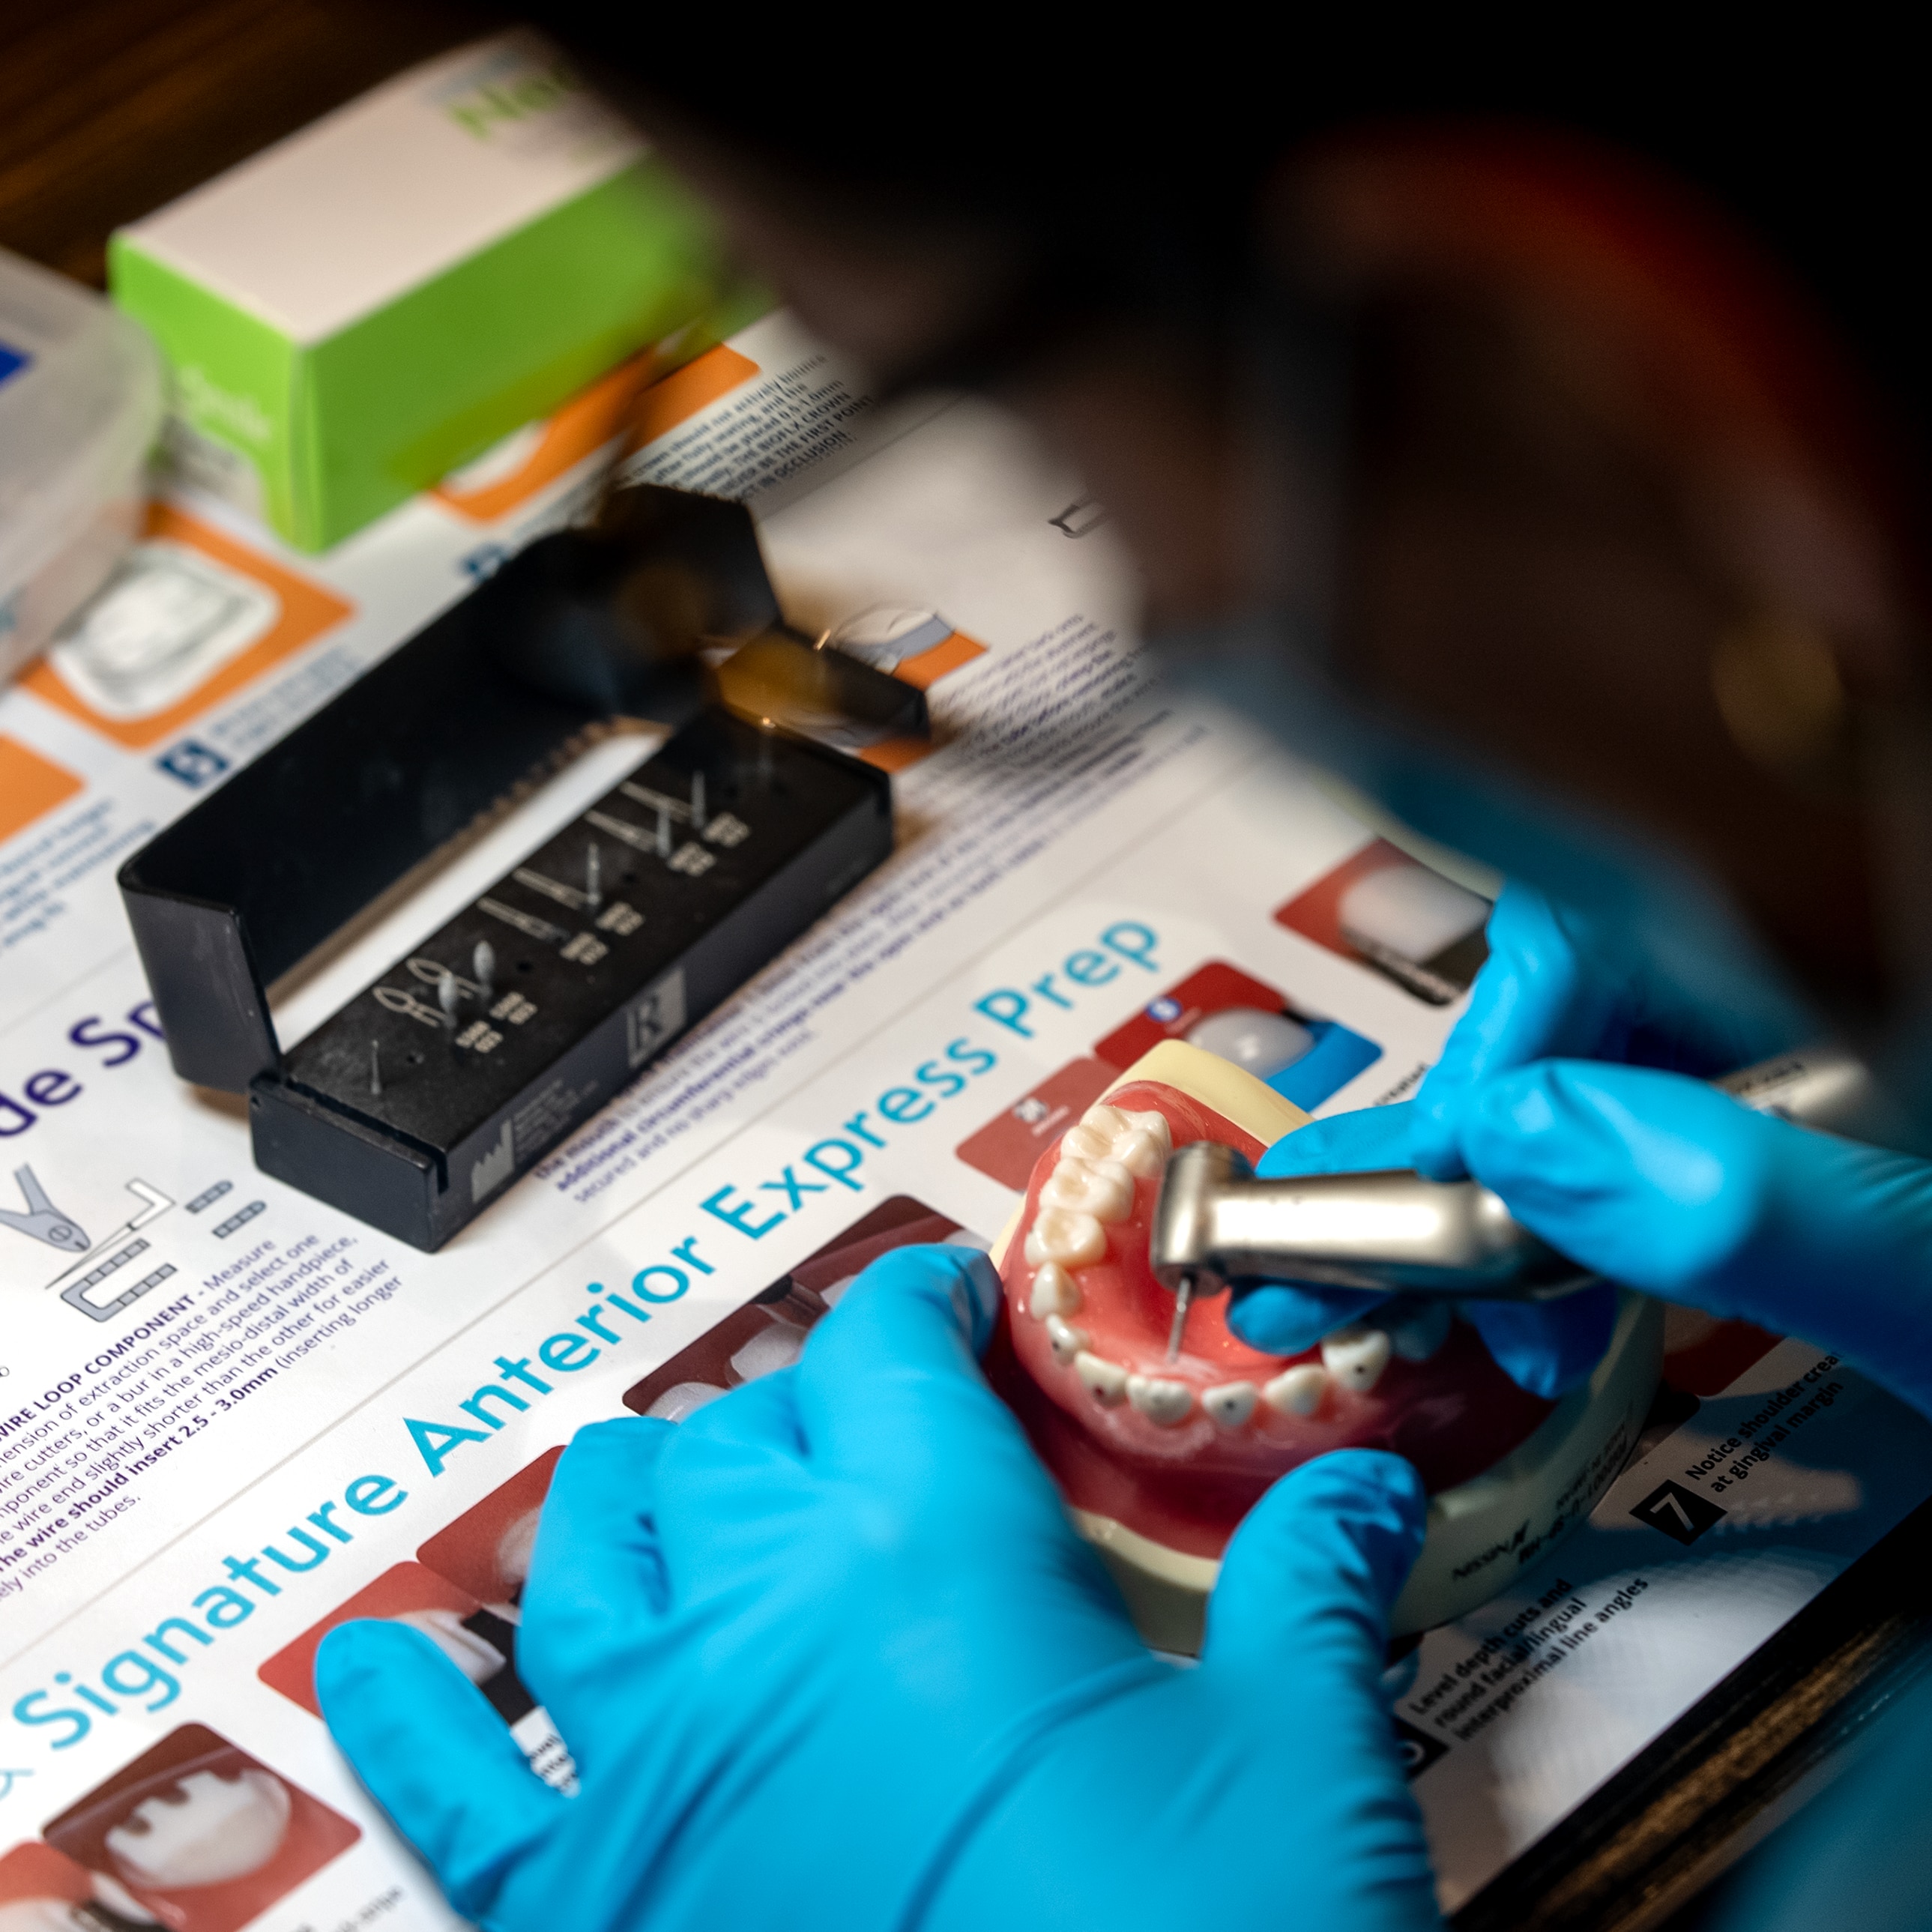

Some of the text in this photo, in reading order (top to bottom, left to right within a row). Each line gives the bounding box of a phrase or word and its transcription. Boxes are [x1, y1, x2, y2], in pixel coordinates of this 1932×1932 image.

[775, 440, 801, 460] THE
[800, 419, 836, 444] FIRST
[802, 391, 852, 424] CROWN
[13, 923, 1156, 1748] Signature Anterior Express Prep
[13, 1504, 52, 1530] wire
[52, 1476, 86, 1503] end
[85, 1437, 144, 1480] slightly
[144, 1394, 202, 1438] shorter
[202, 1367, 244, 1395] than
[241, 1346, 272, 1366] the
[272, 1313, 315, 1345] other
[313, 1294, 340, 1314] for
[342, 1260, 389, 1295] easier
[25, 1430, 88, 1470] cutters,
[86, 1411, 105, 1426] or
[107, 1402, 121, 1412] a
[116, 1380, 149, 1402] bur
[148, 1368, 170, 1380] in
[169, 1357, 183, 1368] a
[178, 1293, 271, 1359] high-speed
[265, 1237, 357, 1296] handpiece,
[34, 1374, 81, 1410] LOOP
[85, 1295, 194, 1374] COMPONENT
[202, 1241, 275, 1290] Measure
[59, 1403, 78, 1420] of
[79, 1349, 160, 1406] extraction
[159, 1315, 207, 1349] space
[208, 1289, 240, 1315] and
[239, 1257, 288, 1292] select
[286, 1235, 319, 1259] one
[65, 1452, 87, 1468] so
[86, 1426, 124, 1452] that
[120, 1416, 139, 1427] it
[134, 1397, 165, 1416] fits
[163, 1377, 194, 1396] the
[193, 1305, 289, 1376] mesio-distal
[288, 1275, 335, 1307] width
[335, 1258, 353, 1275] of
[26, 1518, 68, 1547] wire
[68, 1473, 129, 1518] should
[125, 1437, 183, 1475] insert
[178, 1416, 208, 1437] 2.5
[216, 1368, 278, 1411] 3.0mm
[275, 1313, 356, 1368] (inserting
[347, 1276, 402, 1314] longer
[1685, 1350, 1842, 1480] Notice shoulder crea
[1711, 1380, 1844, 1493] at gingival margin
[19, 1553, 57, 1578] into
[55, 1531, 88, 1553] the
[85, 1497, 140, 1531] tubes.
[1649, 1491, 1695, 1533] 7
[1409, 1578, 1573, 1715] Level depth cuts and
[1434, 1597, 1587, 1727] round facial/lingual
[1453, 1578, 1649, 1742] interproximal line angles
